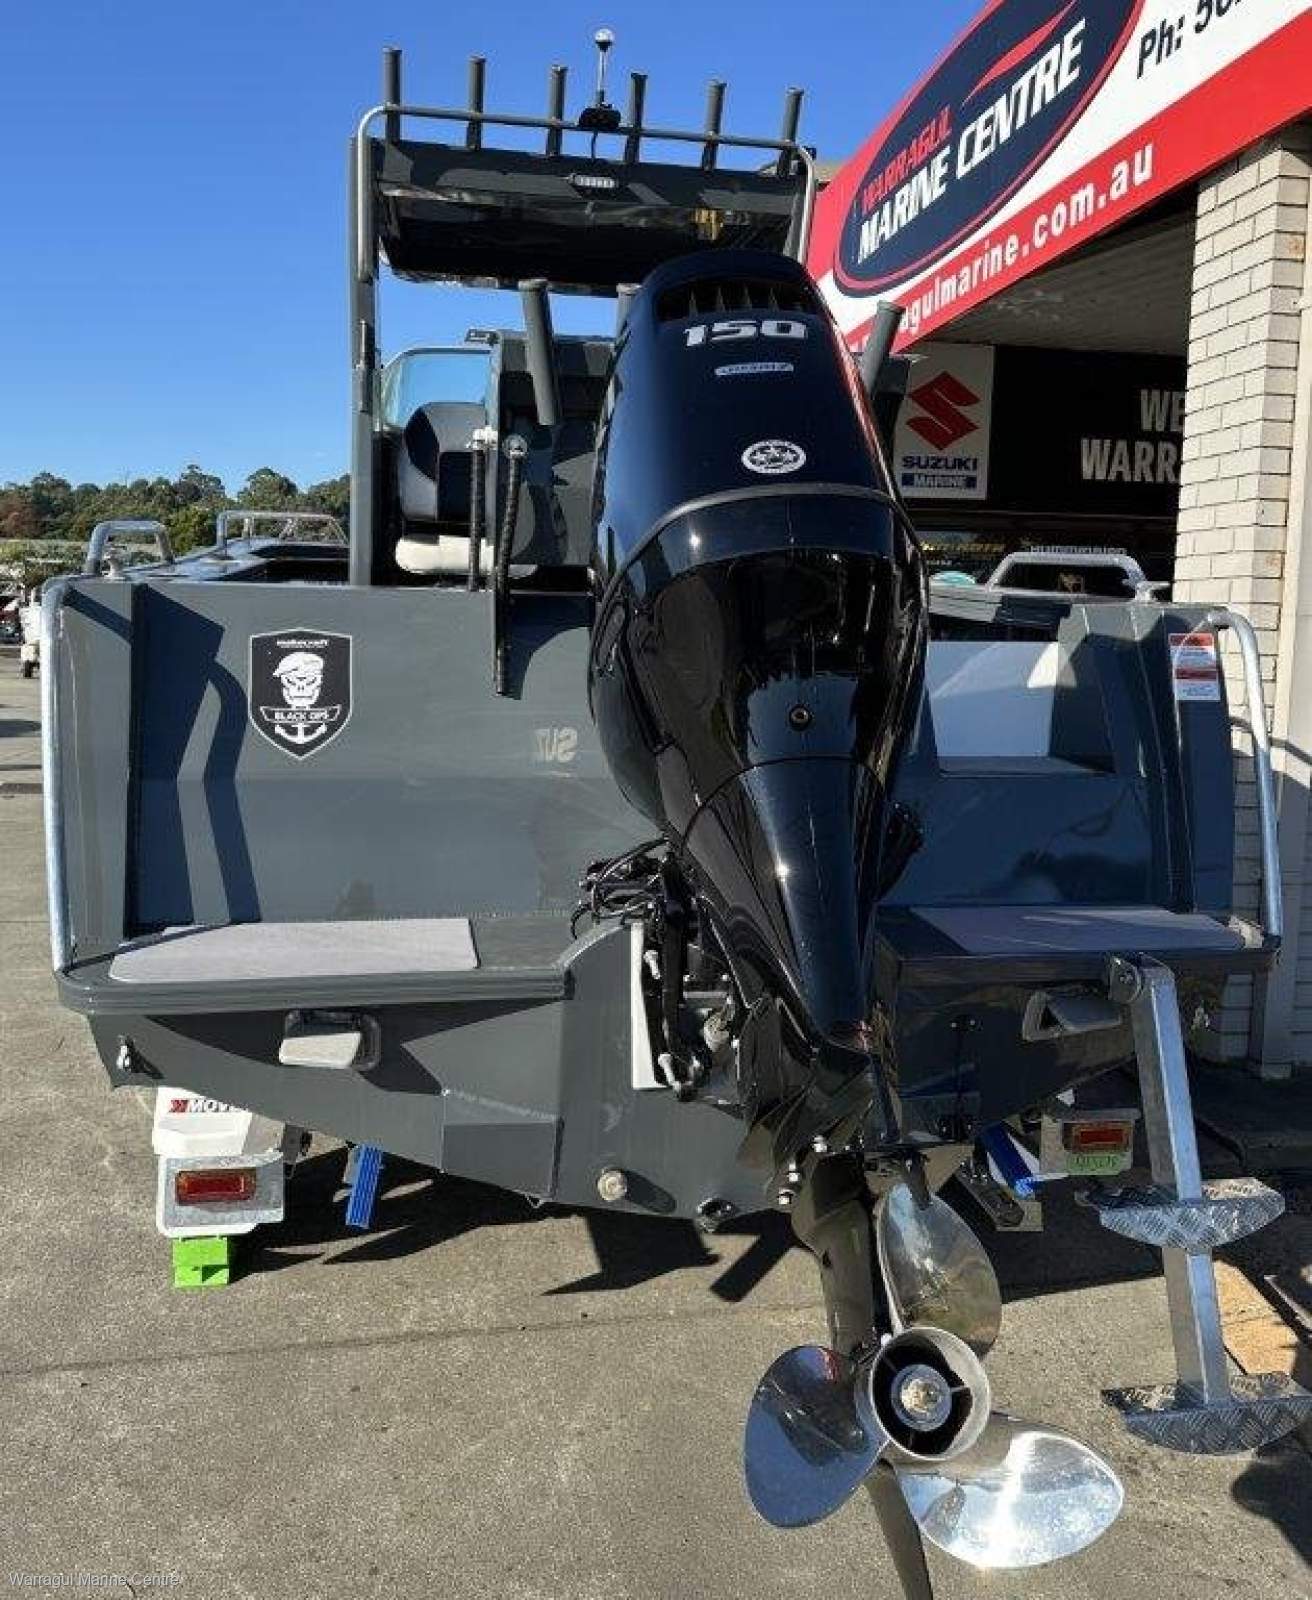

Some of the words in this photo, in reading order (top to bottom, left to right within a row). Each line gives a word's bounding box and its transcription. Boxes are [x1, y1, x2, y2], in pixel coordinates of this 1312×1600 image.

[1137, 18, 1185, 79] Ph:
[857, 146, 951, 265] MARINE
[955, 18, 1087, 182] CENTRE
[898, 143, 1154, 333] agulmarine.com.au
[684, 320, 807, 347] 150
[902, 455, 978, 471] SUZUKI
